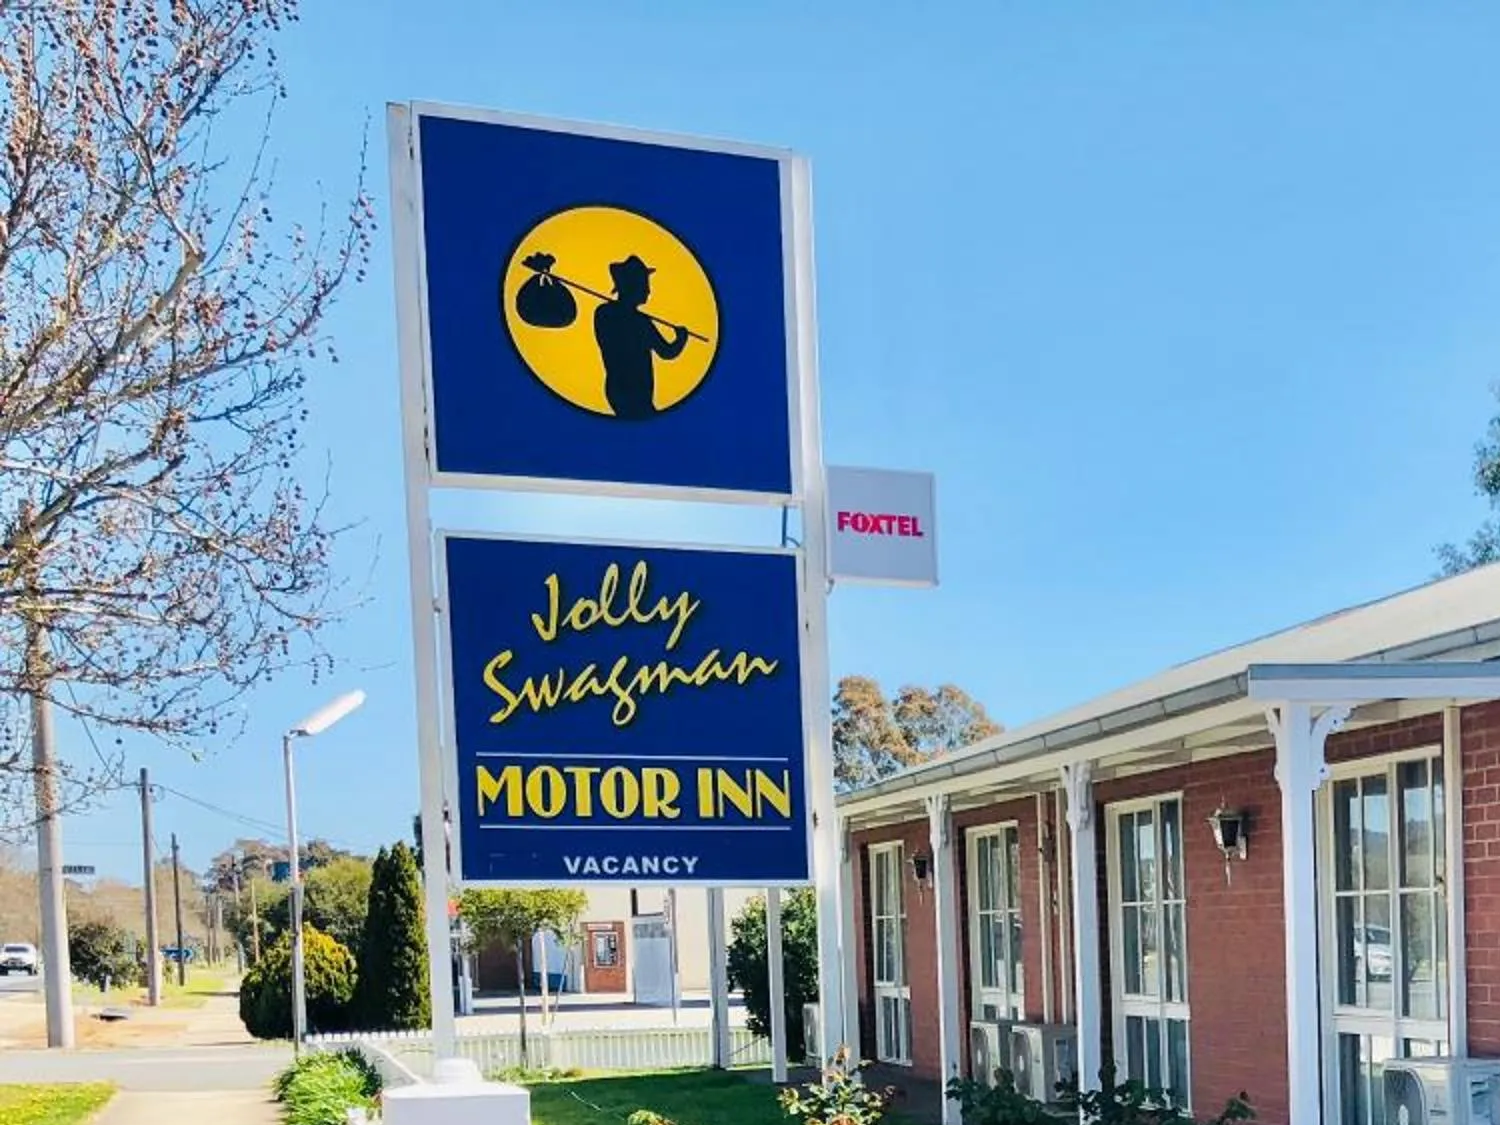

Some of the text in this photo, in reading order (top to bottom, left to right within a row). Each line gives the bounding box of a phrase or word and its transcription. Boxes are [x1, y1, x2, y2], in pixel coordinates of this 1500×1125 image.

[837, 511, 924, 537] FOXTEL
[531, 560, 700, 648] Jolly
[482, 647, 778, 726] Swagman
[475, 765, 791, 819] MOTOR INN
[563, 855, 699, 875] VACANCY
